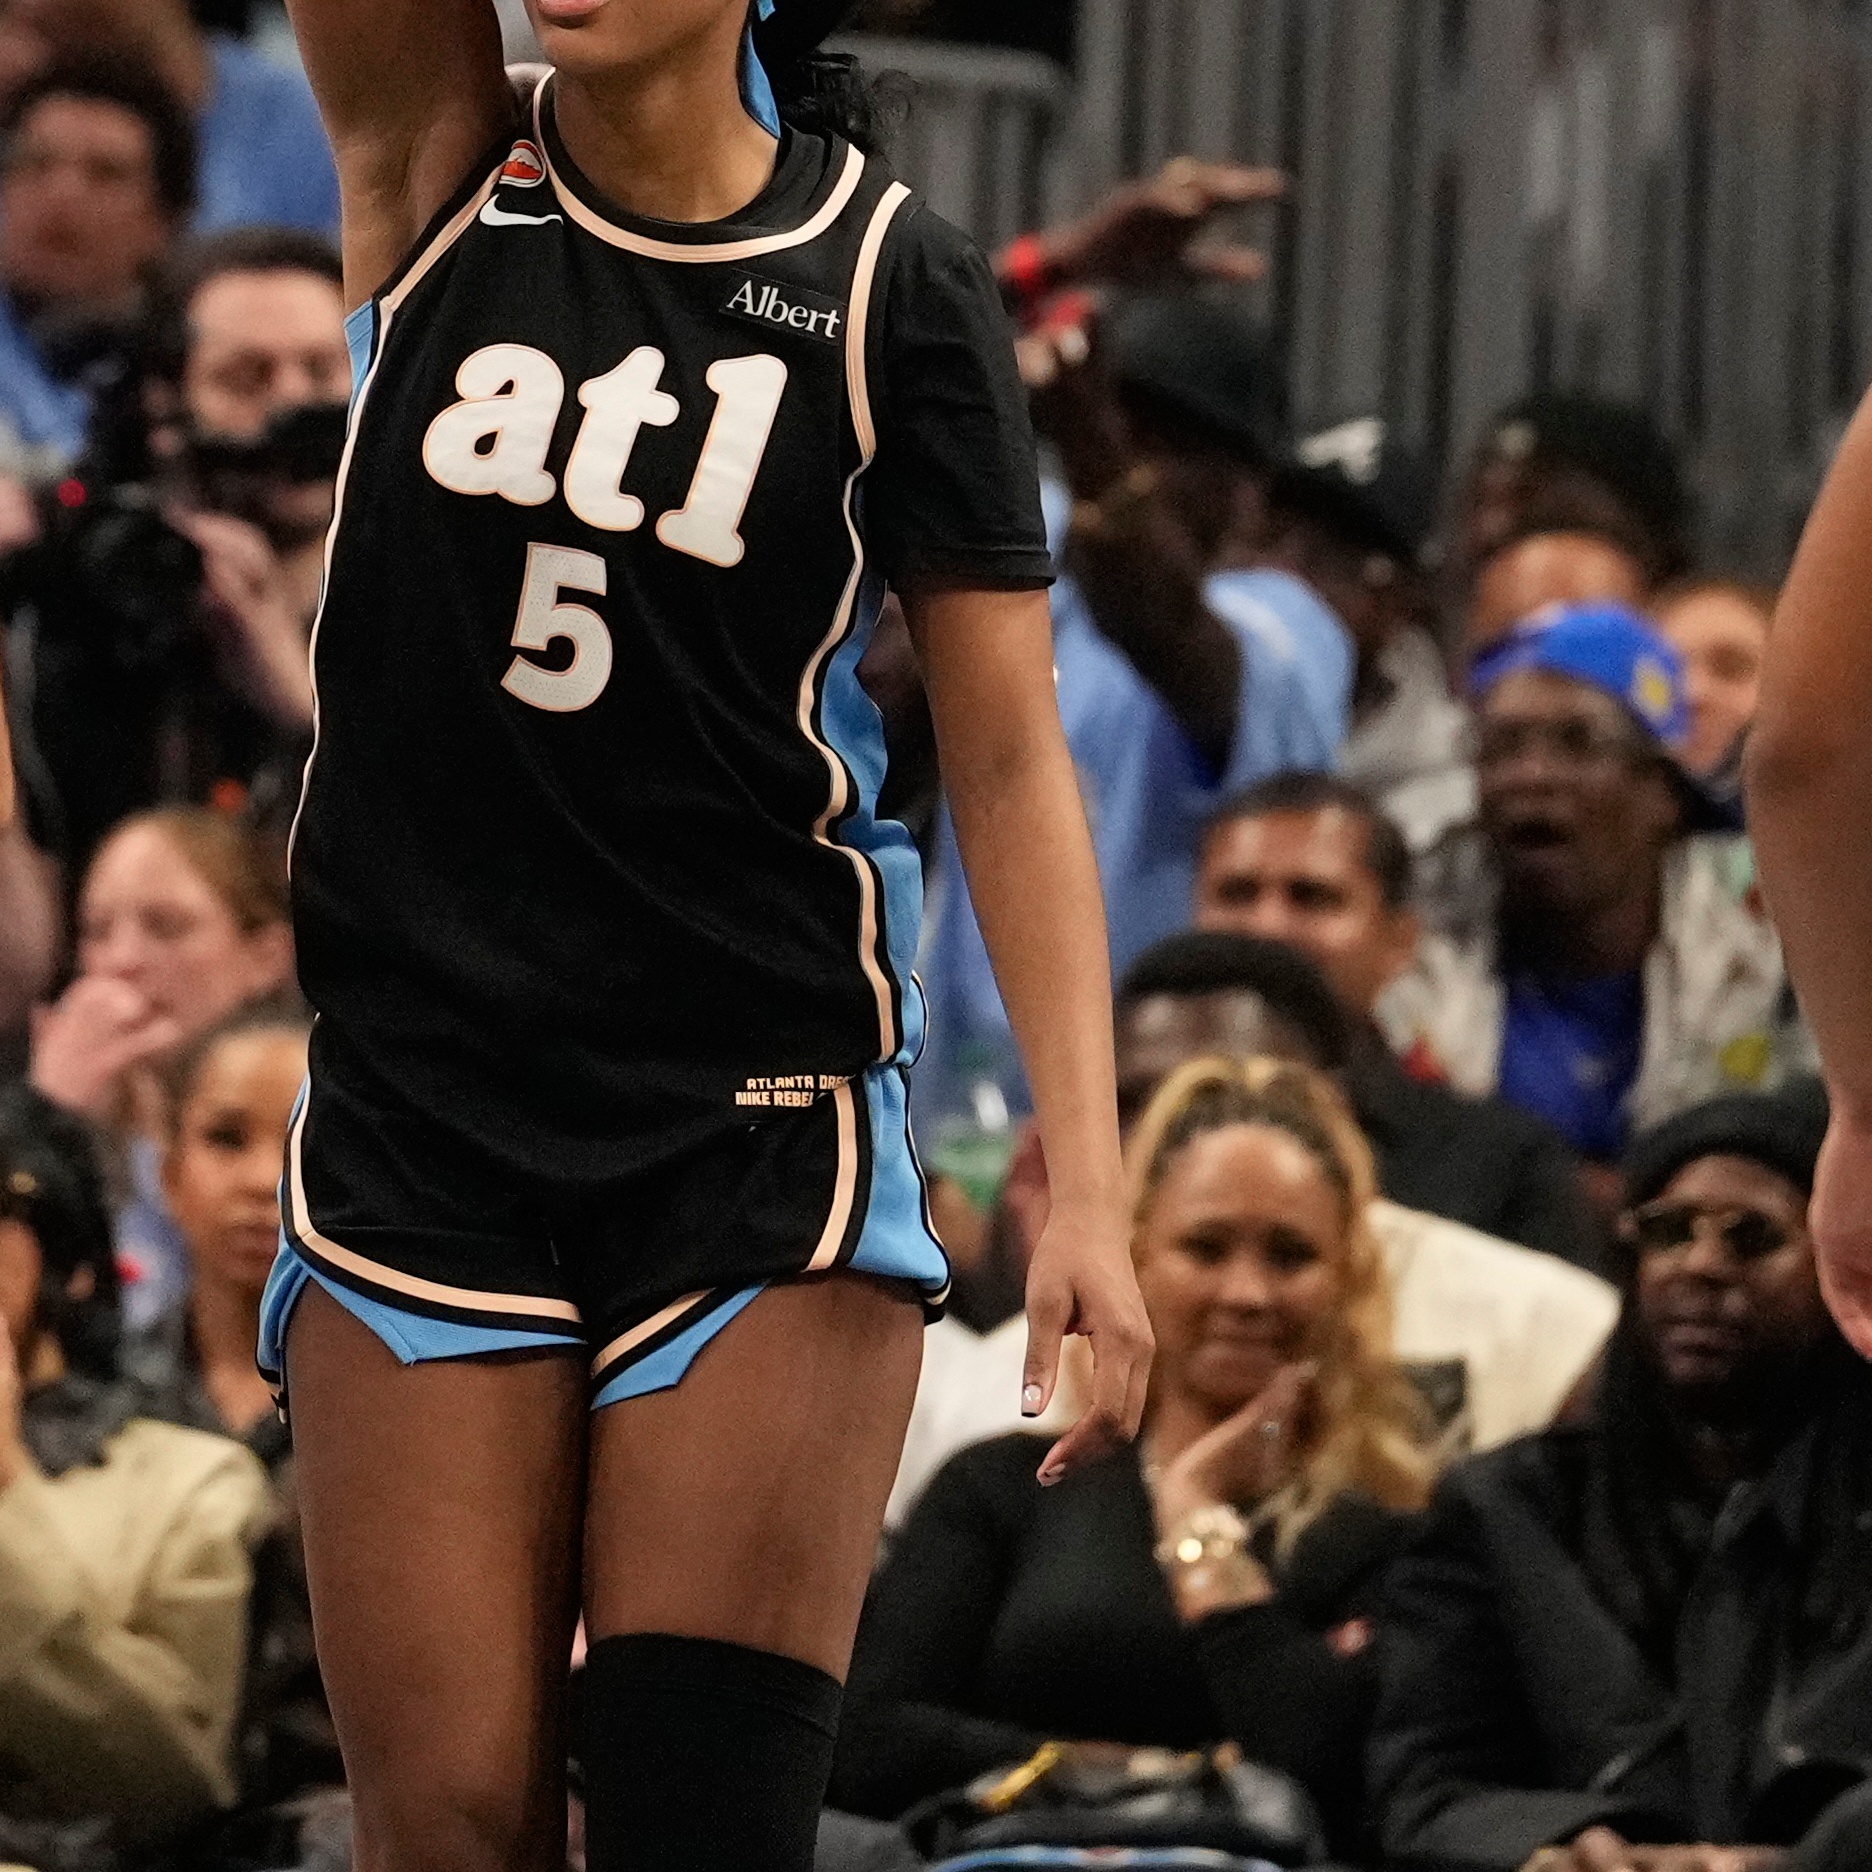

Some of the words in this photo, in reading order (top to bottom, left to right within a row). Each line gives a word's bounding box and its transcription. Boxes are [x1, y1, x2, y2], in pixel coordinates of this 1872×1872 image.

[726, 279, 841, 339] Albert
[501, 541, 613, 712] 5
[735, 1091, 772, 1106] NIKE
[746, 1075, 815, 1090] ATLANTA
